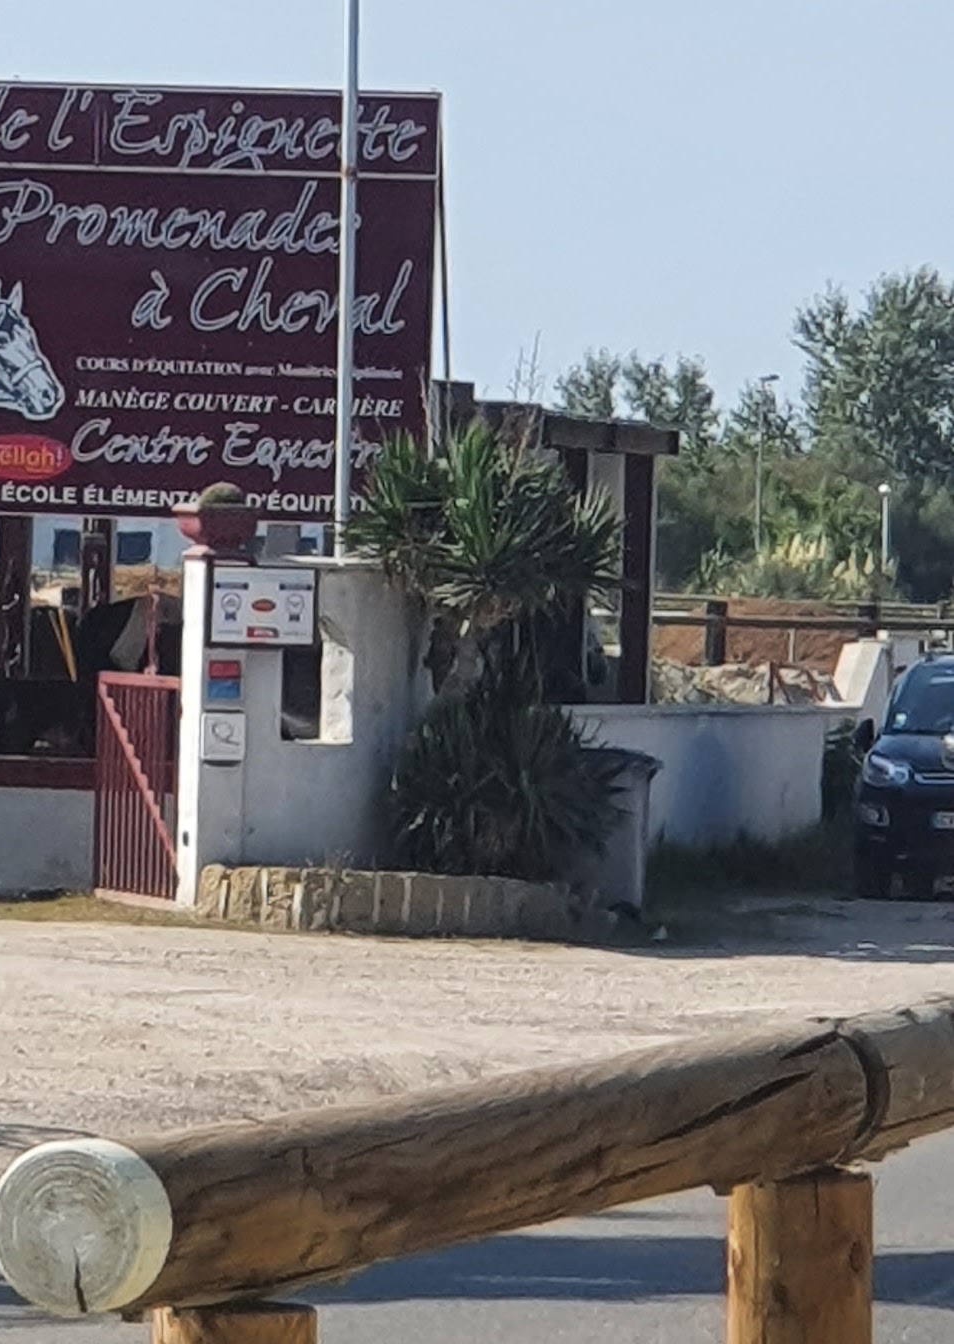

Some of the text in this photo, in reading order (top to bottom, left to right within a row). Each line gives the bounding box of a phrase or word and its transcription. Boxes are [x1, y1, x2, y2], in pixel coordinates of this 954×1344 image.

[131, 270, 173, 330] à
[75, 356, 130, 374] COURS
[132, 357, 243, 377] D'ÉQUITATION
[74, 386, 170, 410] MANÈGE
[173, 392, 279, 414] COUVERT
[293, 392, 404, 418] CARIÈRE
[70, 418, 214, 465] Centre
[0, 481, 77, 505] ÉCOLE
